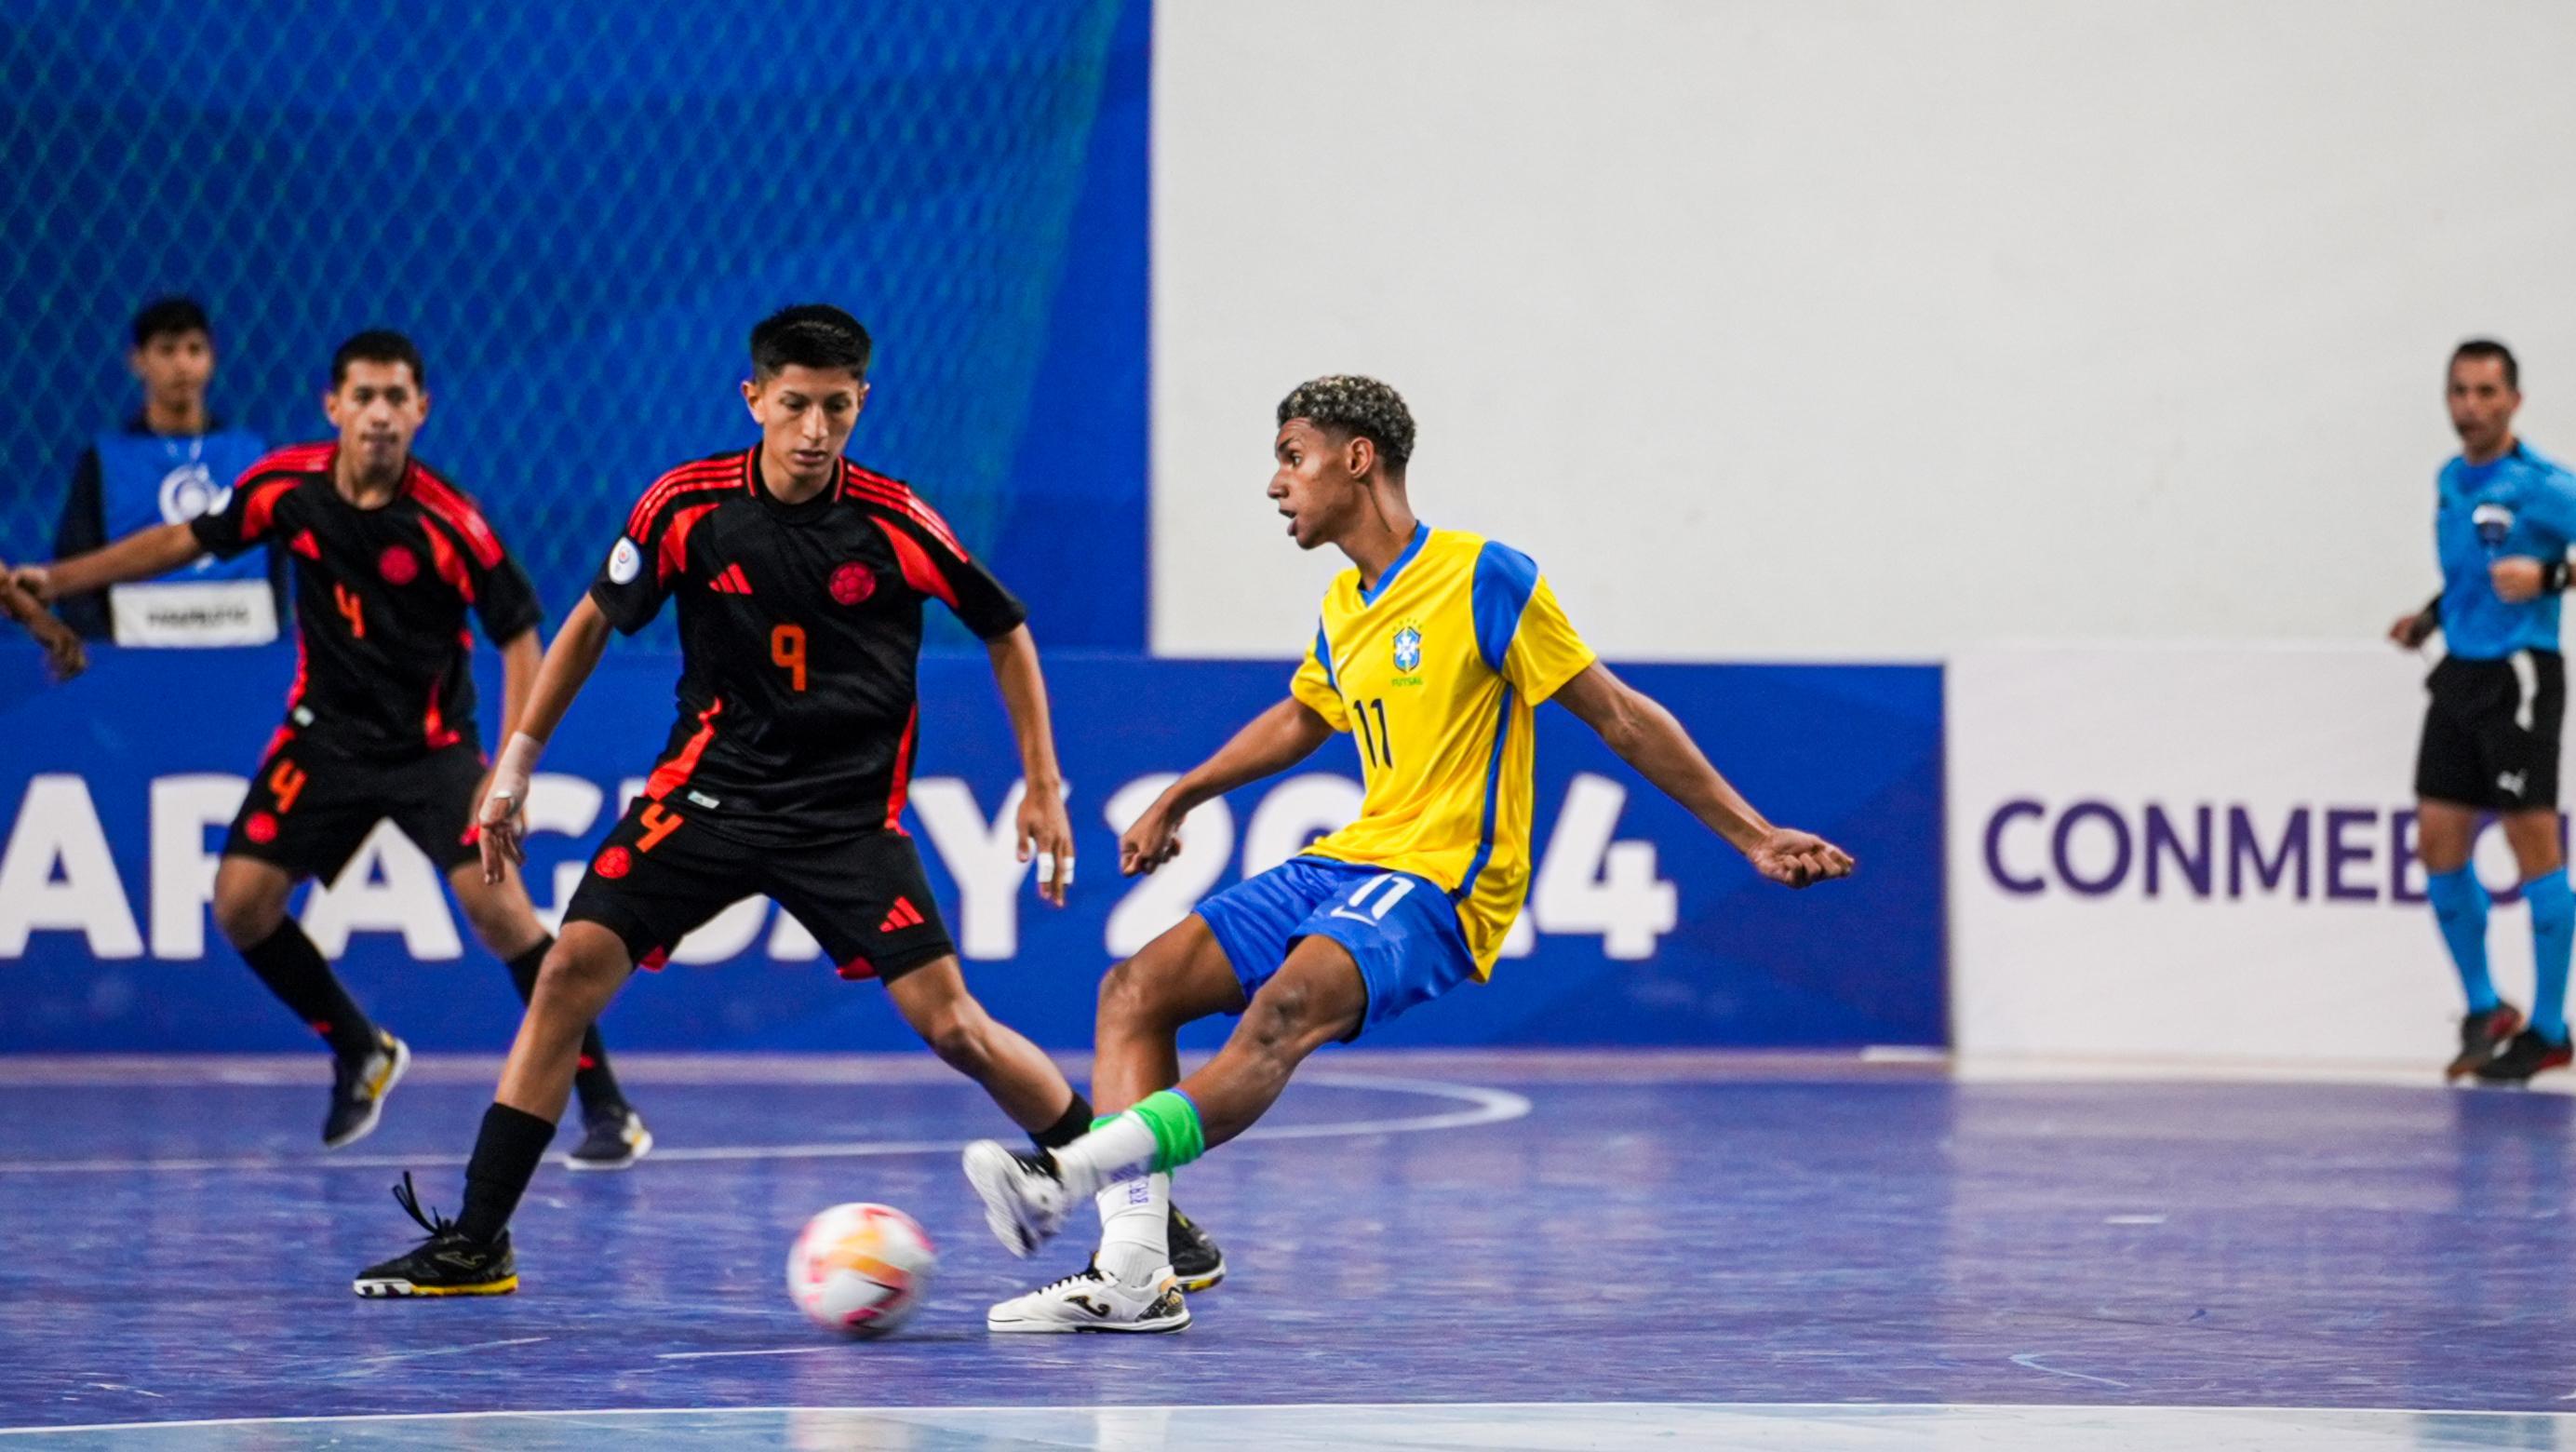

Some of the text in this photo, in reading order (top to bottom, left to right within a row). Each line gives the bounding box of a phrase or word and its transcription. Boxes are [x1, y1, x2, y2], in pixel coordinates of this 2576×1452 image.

[334, 583, 366, 639] 4
[771, 624, 806, 692] 9
[1391, 677, 1424, 687] FUTSAL
[1353, 698, 1393, 770] 11
[269, 758, 307, 813] 4
[635, 801, 684, 854] 4
[1348, 873, 1415, 921] 11
